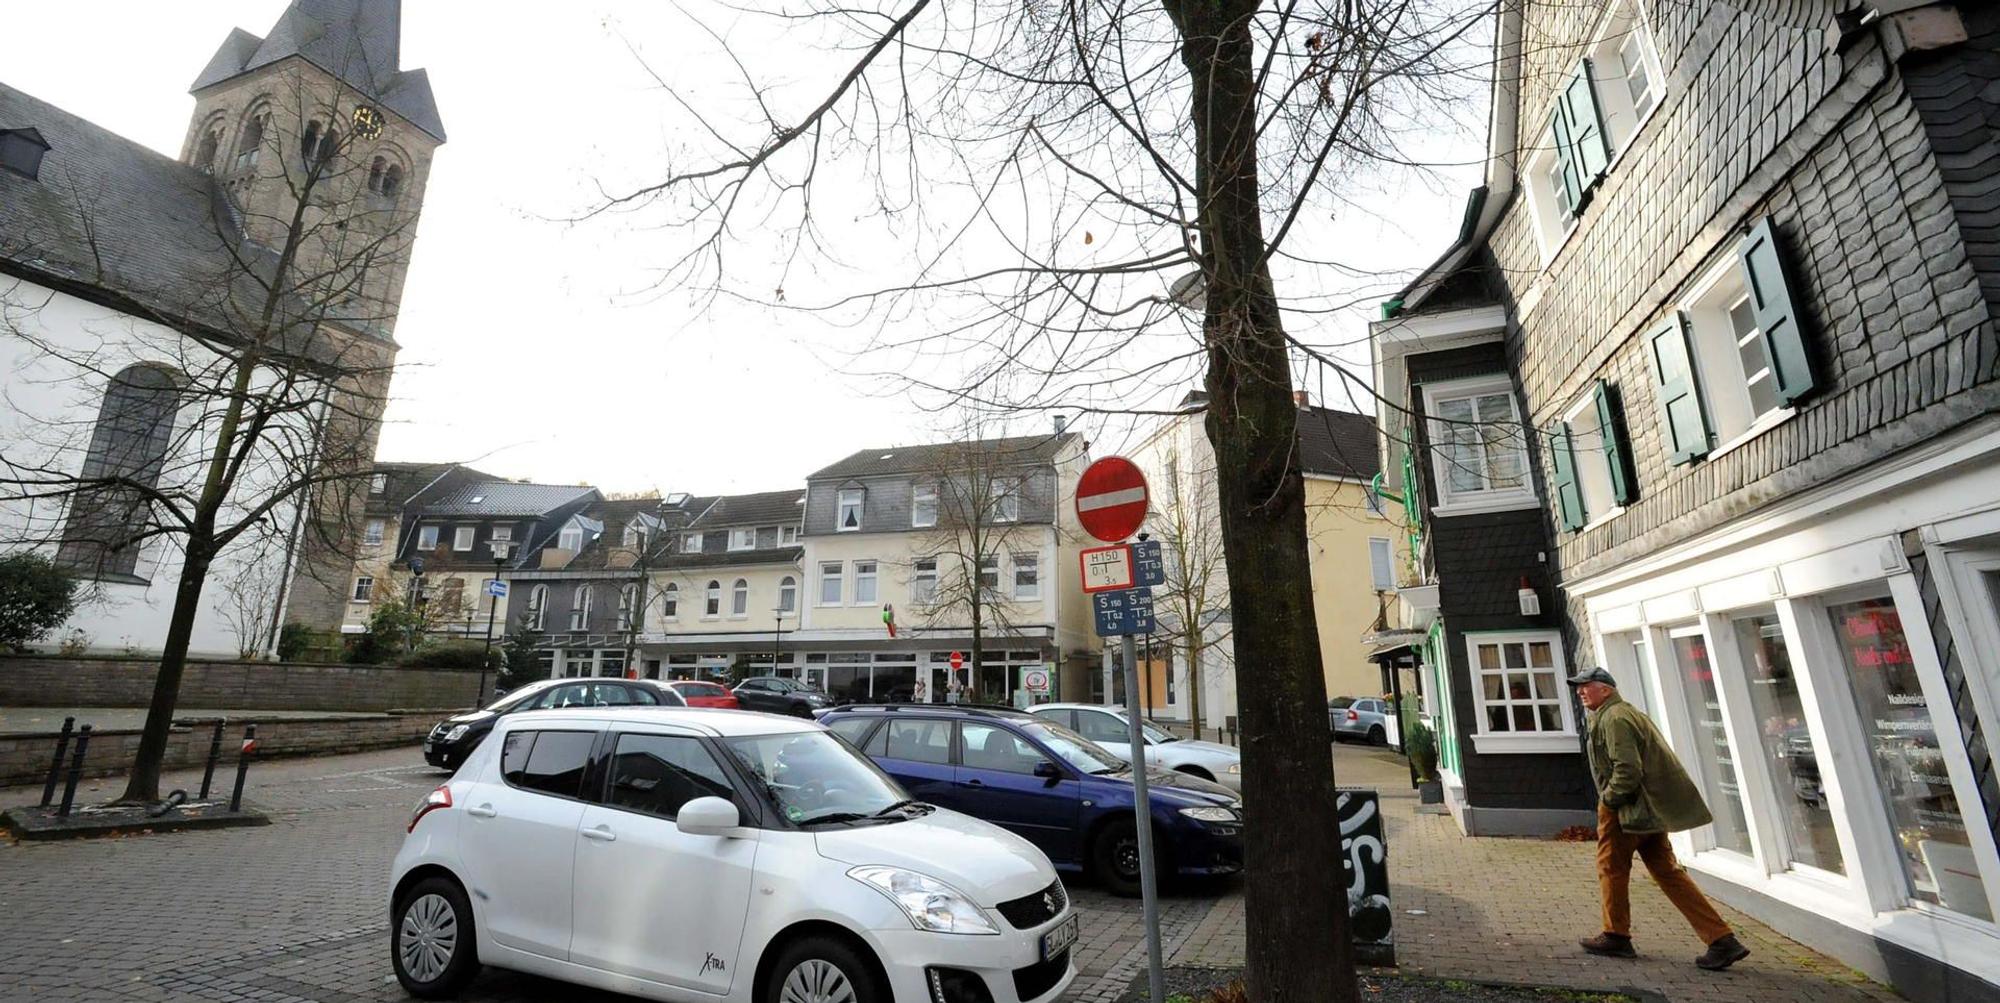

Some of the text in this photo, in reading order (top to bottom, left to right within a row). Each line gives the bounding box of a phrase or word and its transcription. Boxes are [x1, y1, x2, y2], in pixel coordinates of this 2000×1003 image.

[1100, 597, 1108, 608] S
[1129, 594, 1137, 605] S
[698, 952, 726, 976] X-TRA
